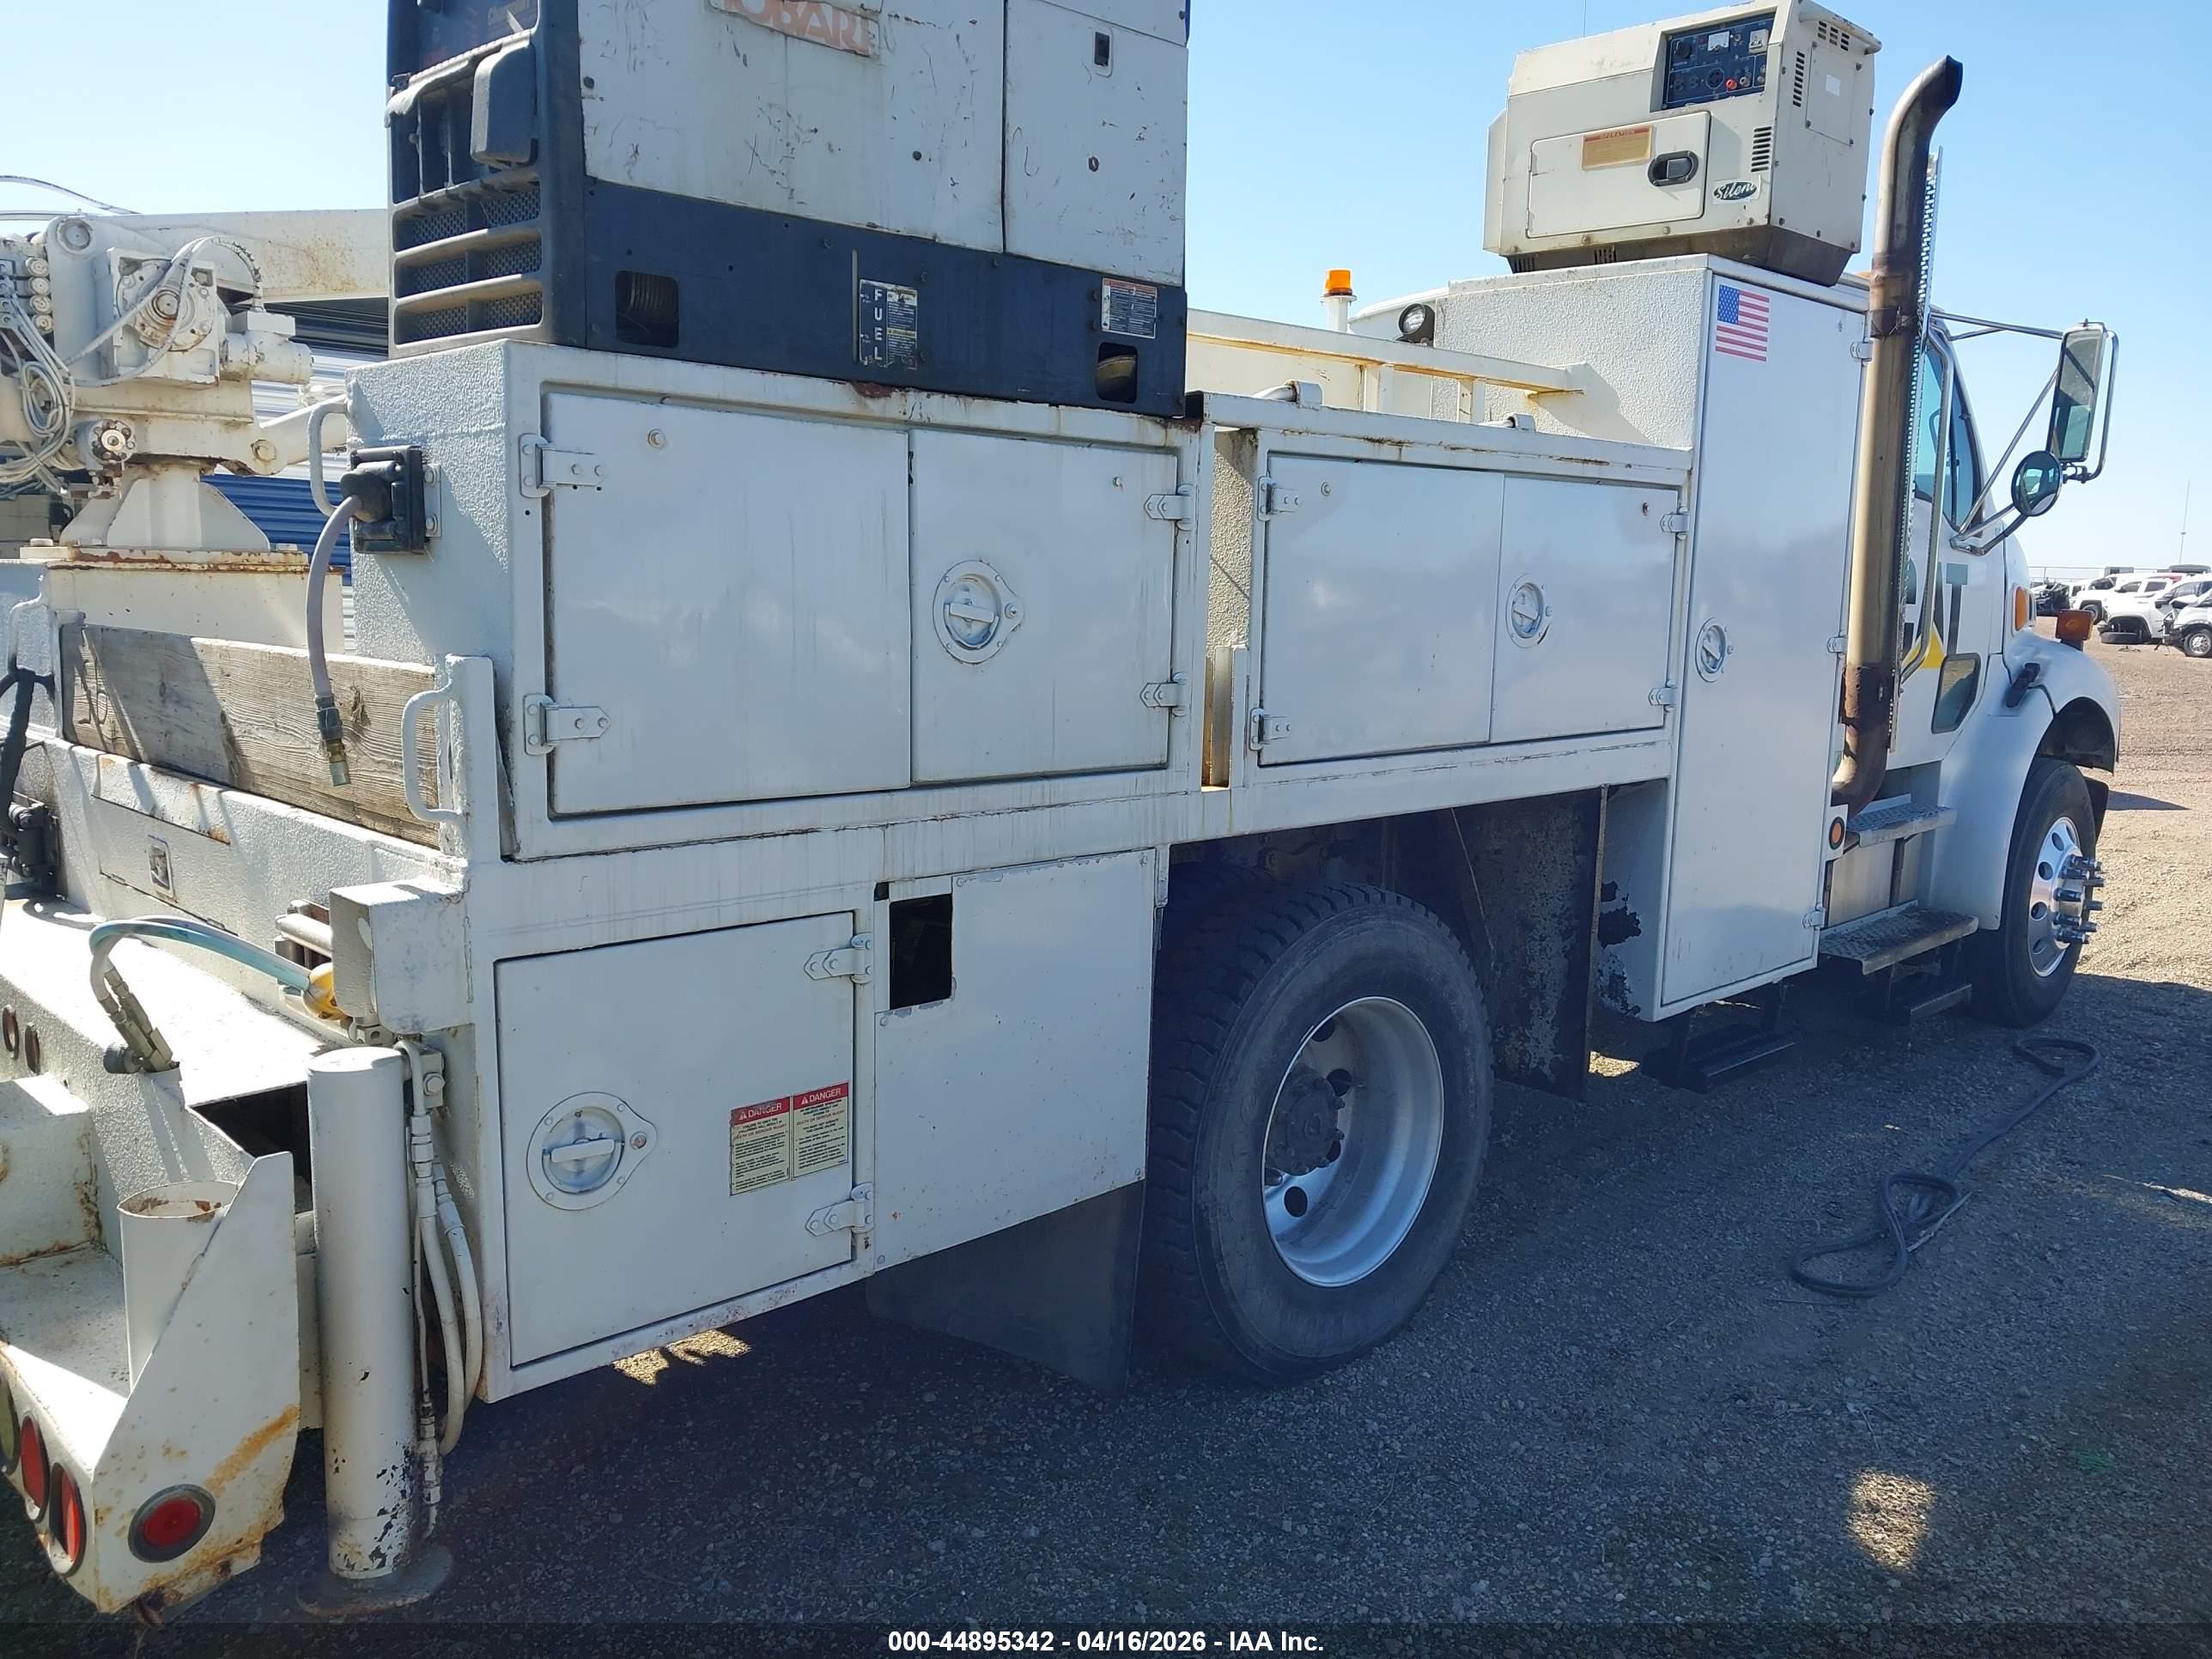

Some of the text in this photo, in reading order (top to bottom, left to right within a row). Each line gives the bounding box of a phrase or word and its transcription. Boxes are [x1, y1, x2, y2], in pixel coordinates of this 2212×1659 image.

[722, 0, 870, 56] OBAR
[873, 289, 884, 361] FUEL
[748, 1103, 782, 1118] DANGER
[809, 1088, 842, 1103] DANGER
